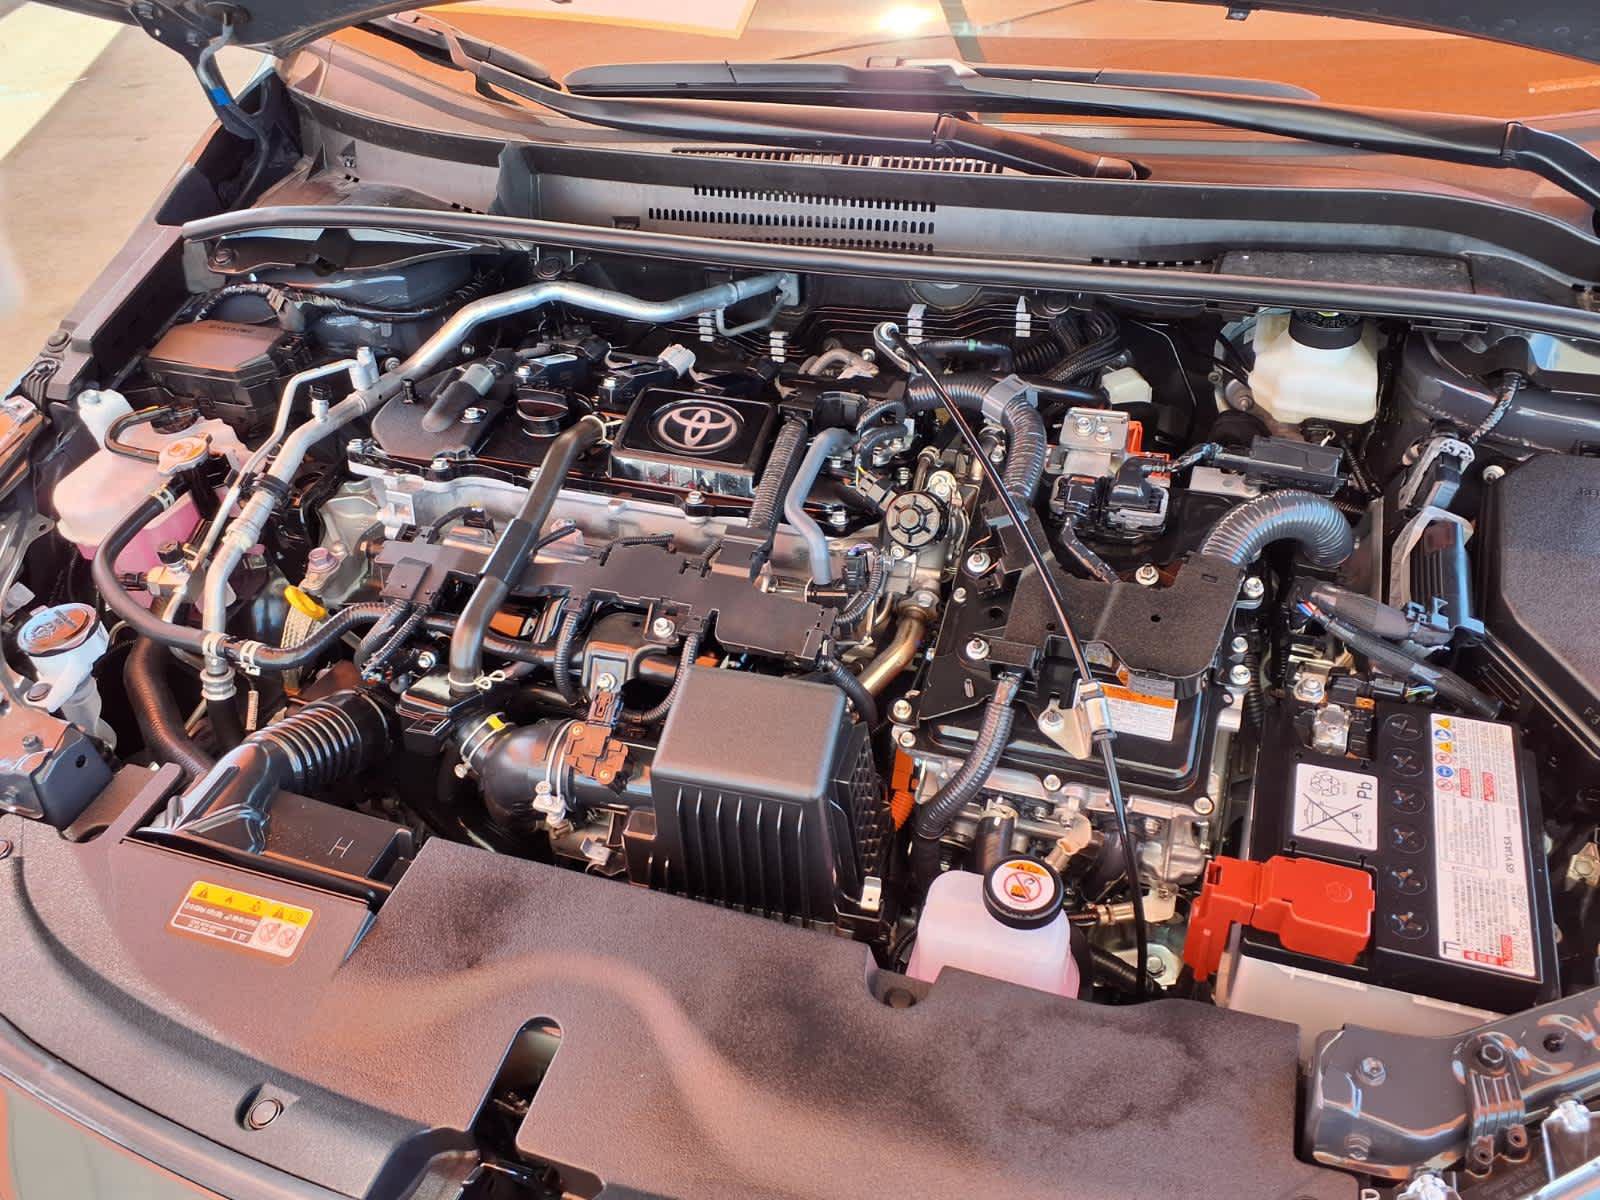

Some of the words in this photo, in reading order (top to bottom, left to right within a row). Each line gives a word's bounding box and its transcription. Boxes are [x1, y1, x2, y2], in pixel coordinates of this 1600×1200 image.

[1357, 781, 1373, 800] Pb
[326, 836, 355, 858] H
[1503, 836, 1513, 861] YUASA
[1505, 863, 1514, 873] GS
